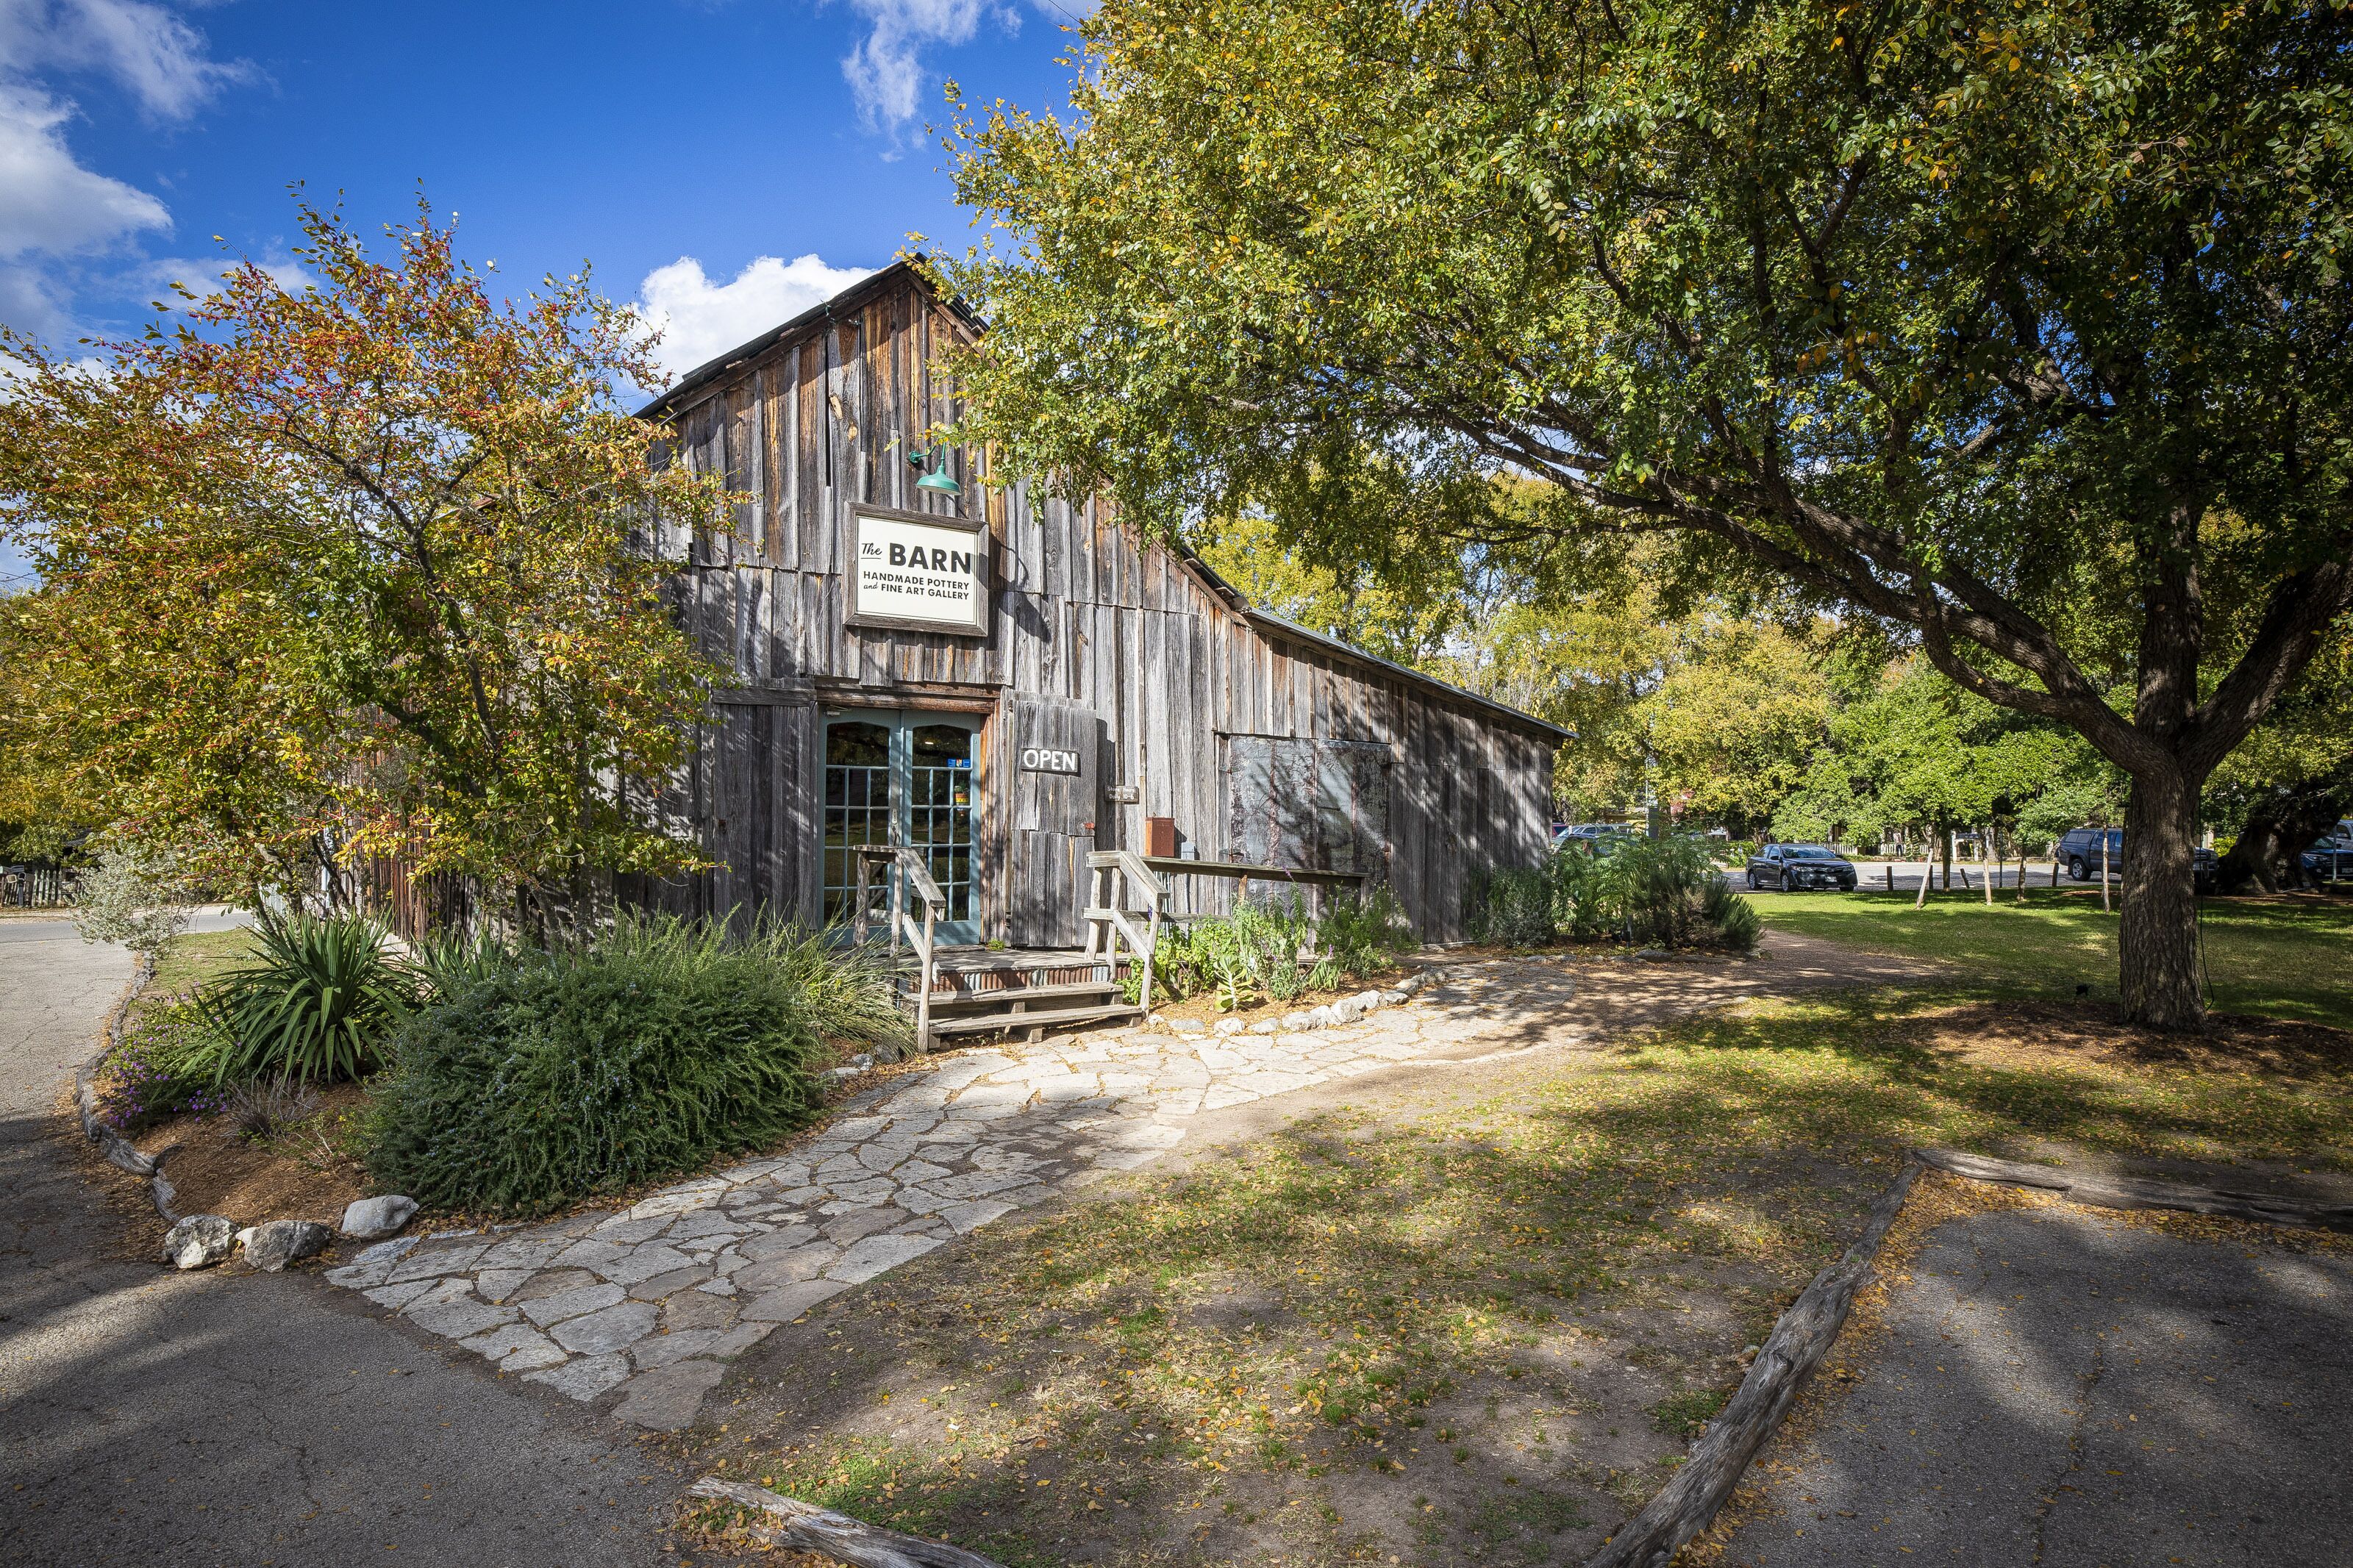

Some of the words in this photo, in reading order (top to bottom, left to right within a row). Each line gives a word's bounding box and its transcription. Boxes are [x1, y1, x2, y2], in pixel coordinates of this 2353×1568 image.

[861, 543, 882, 556] The
[889, 543, 971, 574] BARN
[863, 571, 924, 585] HANDMADE
[927, 579, 970, 590] POTTERY
[881, 584, 902, 593] FINE
[906, 587, 926, 596] ART
[928, 589, 969, 601] GALLERY
[1024, 749, 1076, 771] OPEN
[1109, 793, 1121, 801] Daily
